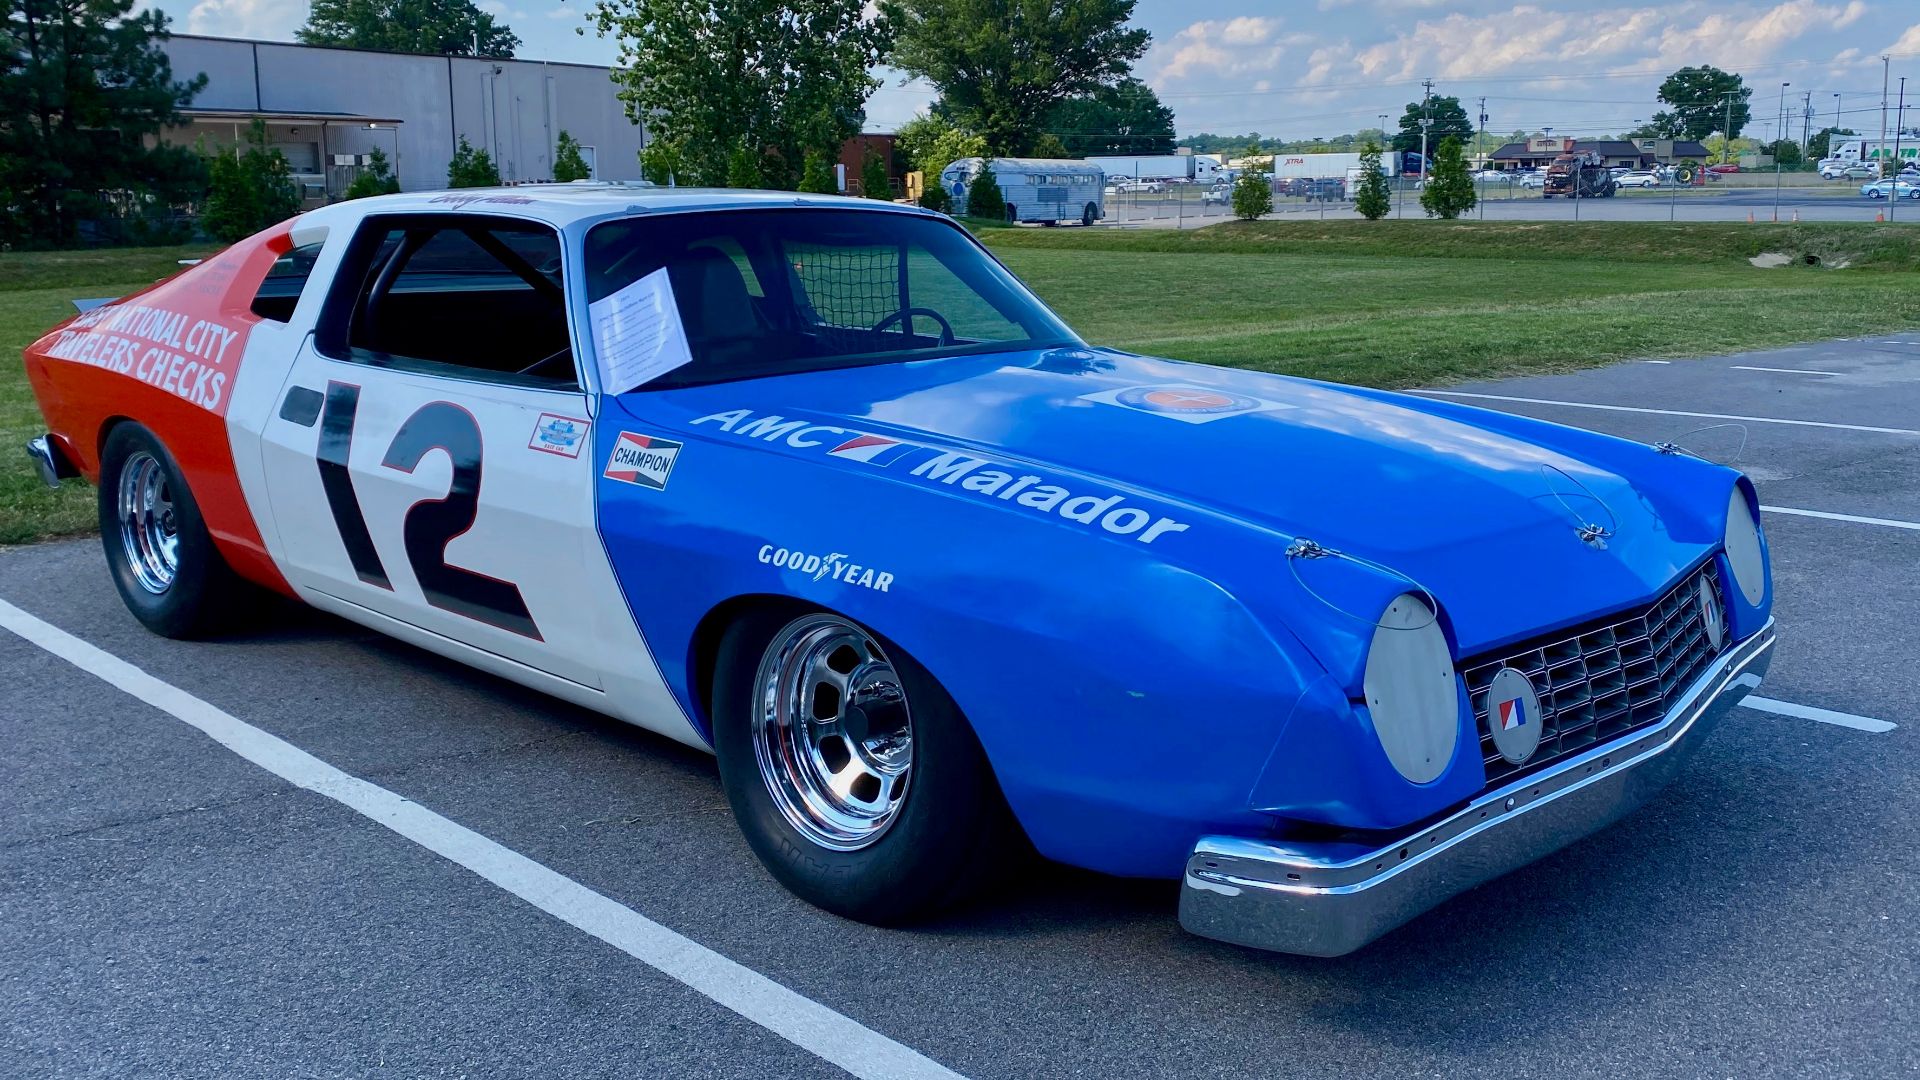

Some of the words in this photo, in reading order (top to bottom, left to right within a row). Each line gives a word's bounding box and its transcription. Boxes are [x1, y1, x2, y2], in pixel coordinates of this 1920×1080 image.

[1284, 158, 1304, 166] XTRA
[106, 304, 190, 350] NATIONAL
[185, 319, 239, 364] CITY
[46, 330, 142, 374] TRAVELERS
[136, 347, 226, 411] CHECKS
[688, 408, 845, 449] AMC
[614, 447, 671, 473] CHAMPION
[315, 379, 546, 644] 12
[909, 449, 1191, 545] Matador
